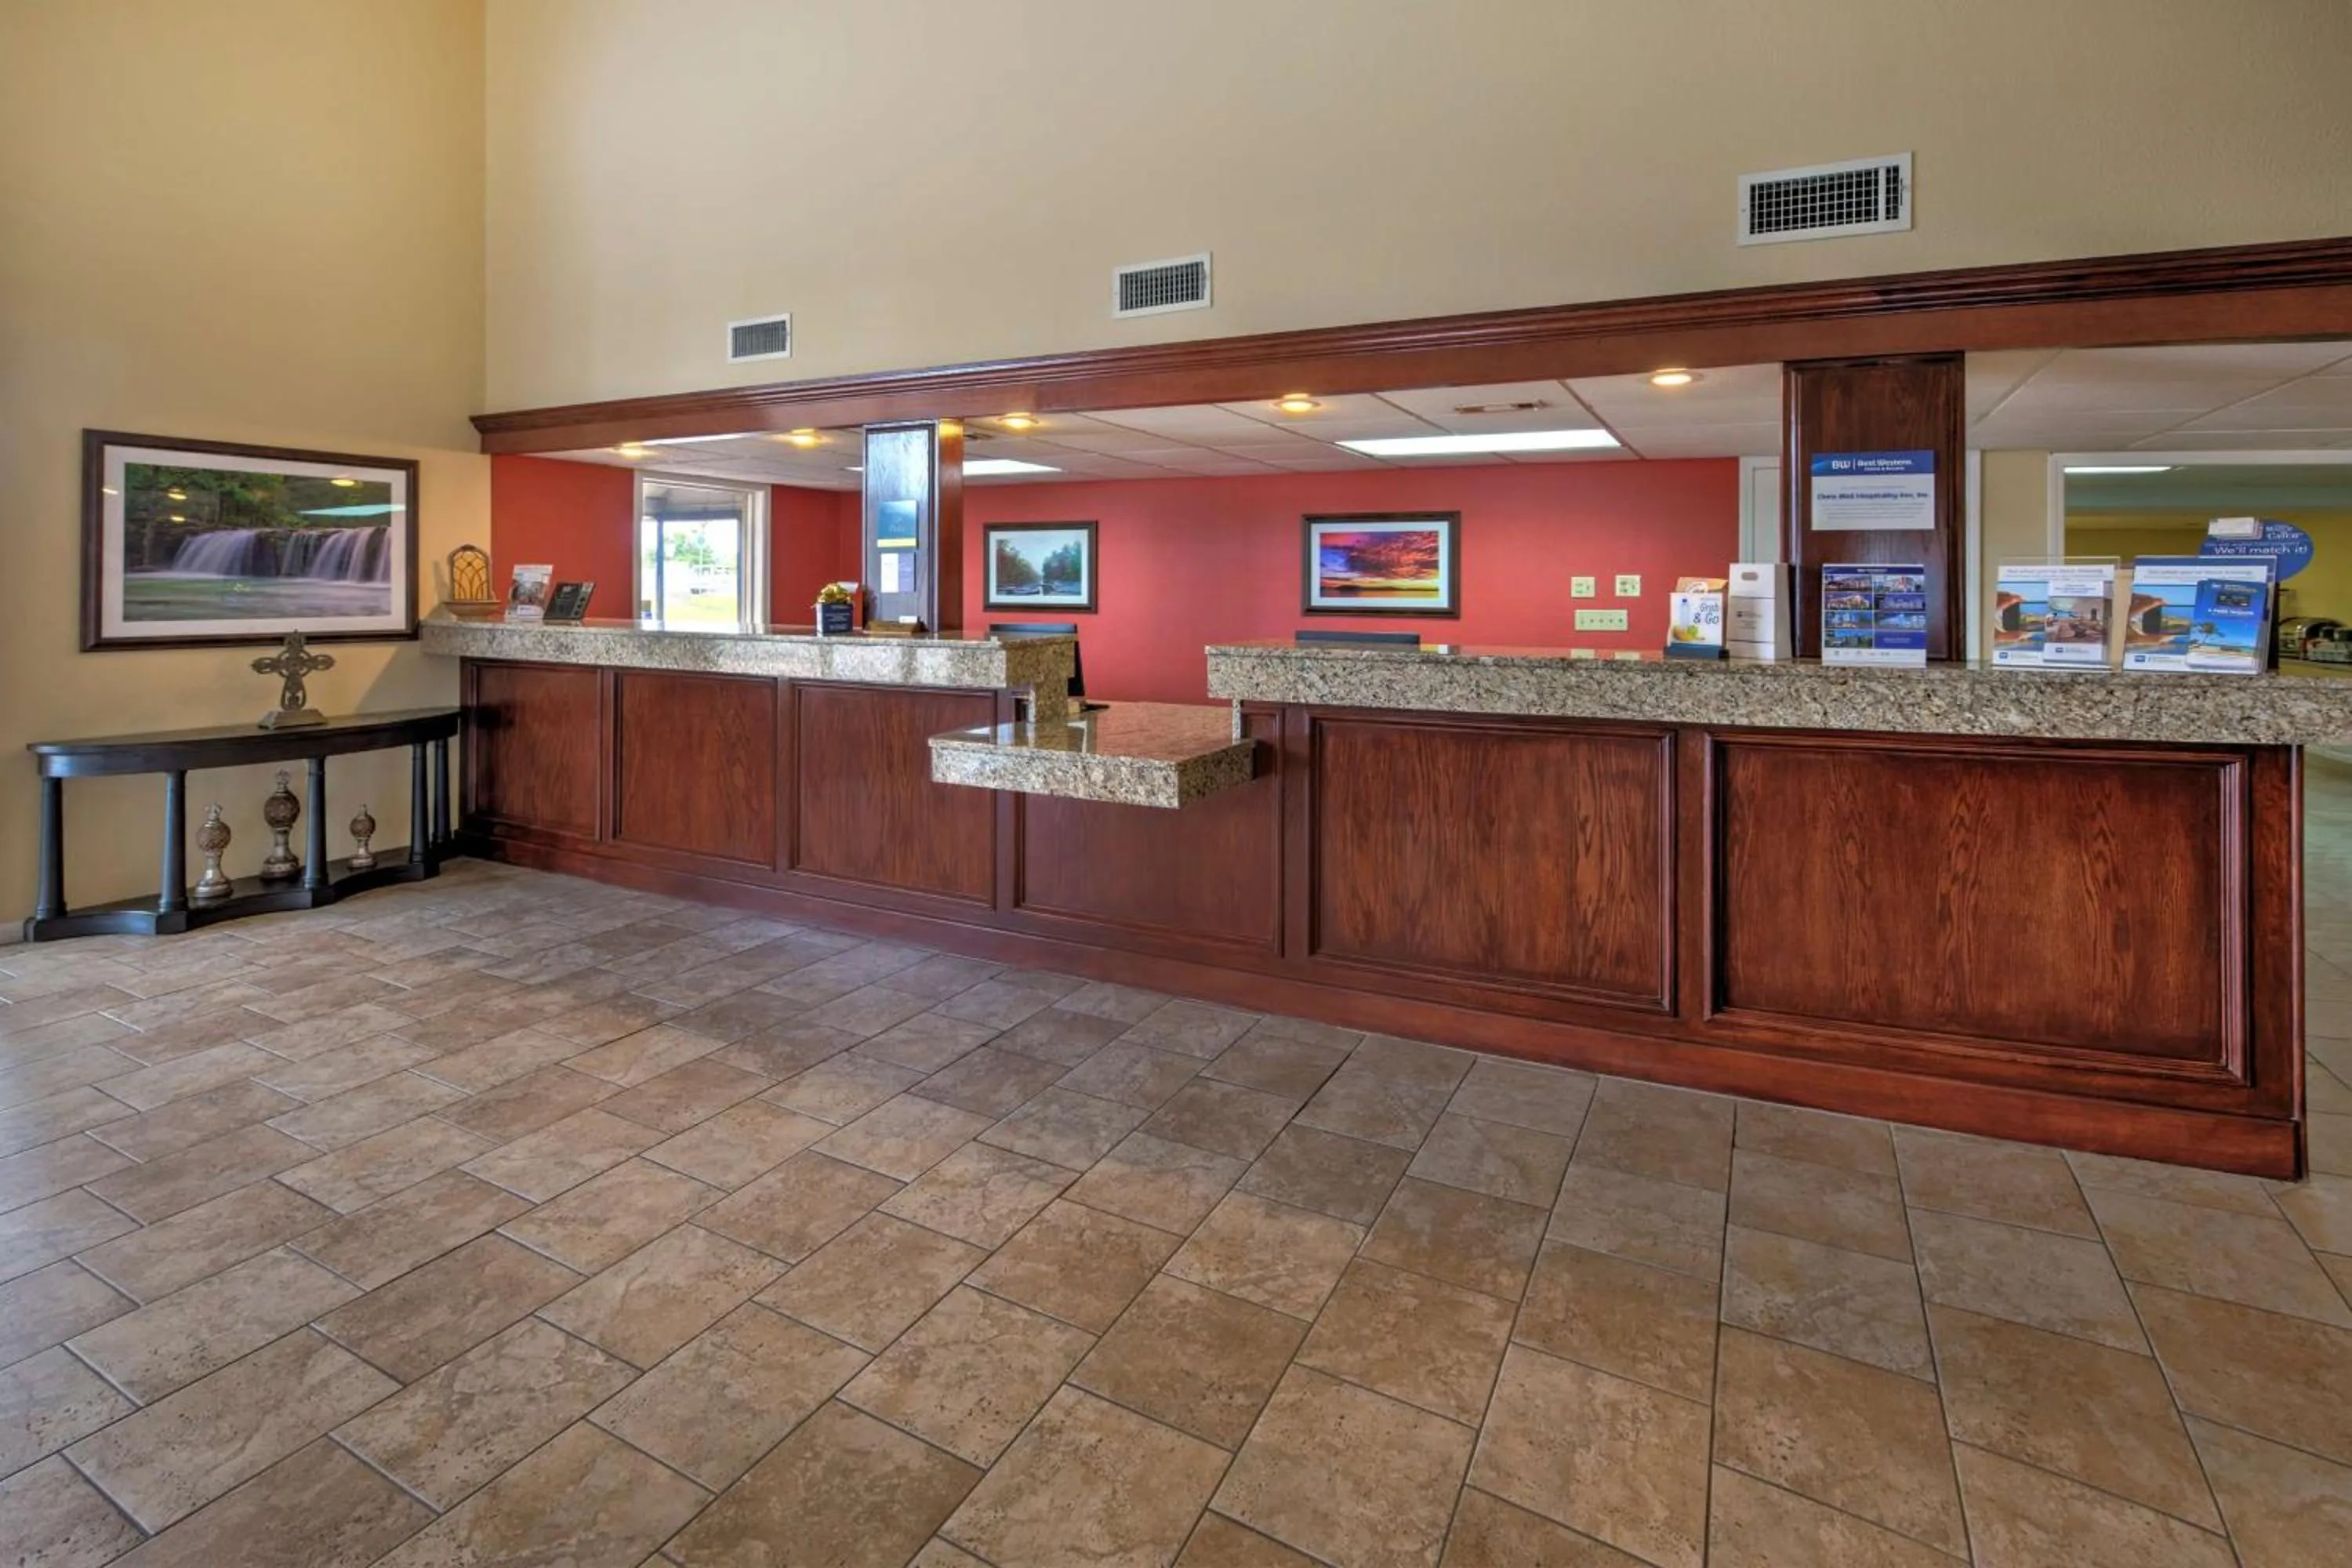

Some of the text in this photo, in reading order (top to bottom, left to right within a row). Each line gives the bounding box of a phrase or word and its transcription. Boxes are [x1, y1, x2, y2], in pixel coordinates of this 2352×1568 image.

[2249, 545, 2290, 554] match
[1700, 602, 1719, 613] Grab
[1693, 612, 1719, 625] & Go
